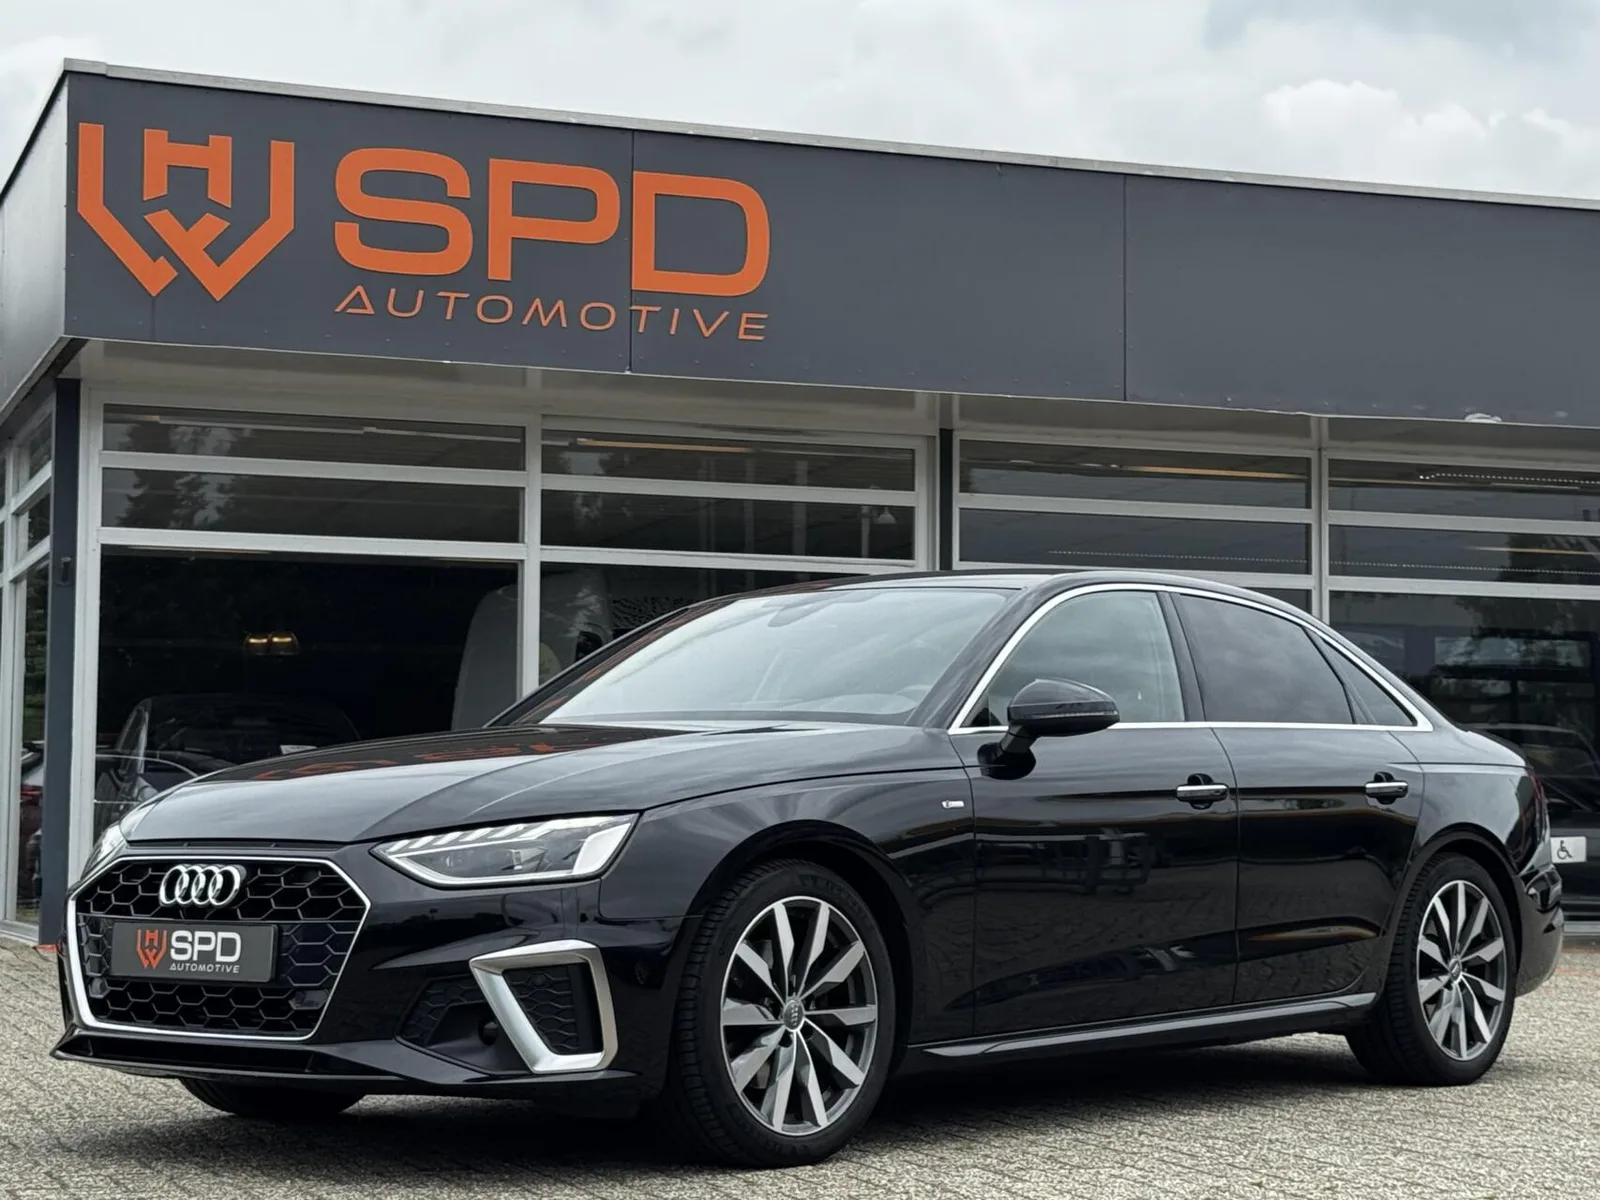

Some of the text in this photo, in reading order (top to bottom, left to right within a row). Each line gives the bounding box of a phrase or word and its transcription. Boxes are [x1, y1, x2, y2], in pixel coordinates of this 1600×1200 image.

[334, 147, 770, 297] SPD
[334, 284, 769, 341] AUTOMOTIVE
[169, 962, 241, 974] AUTOMOTIVE
[170, 930, 242, 963] SPD
